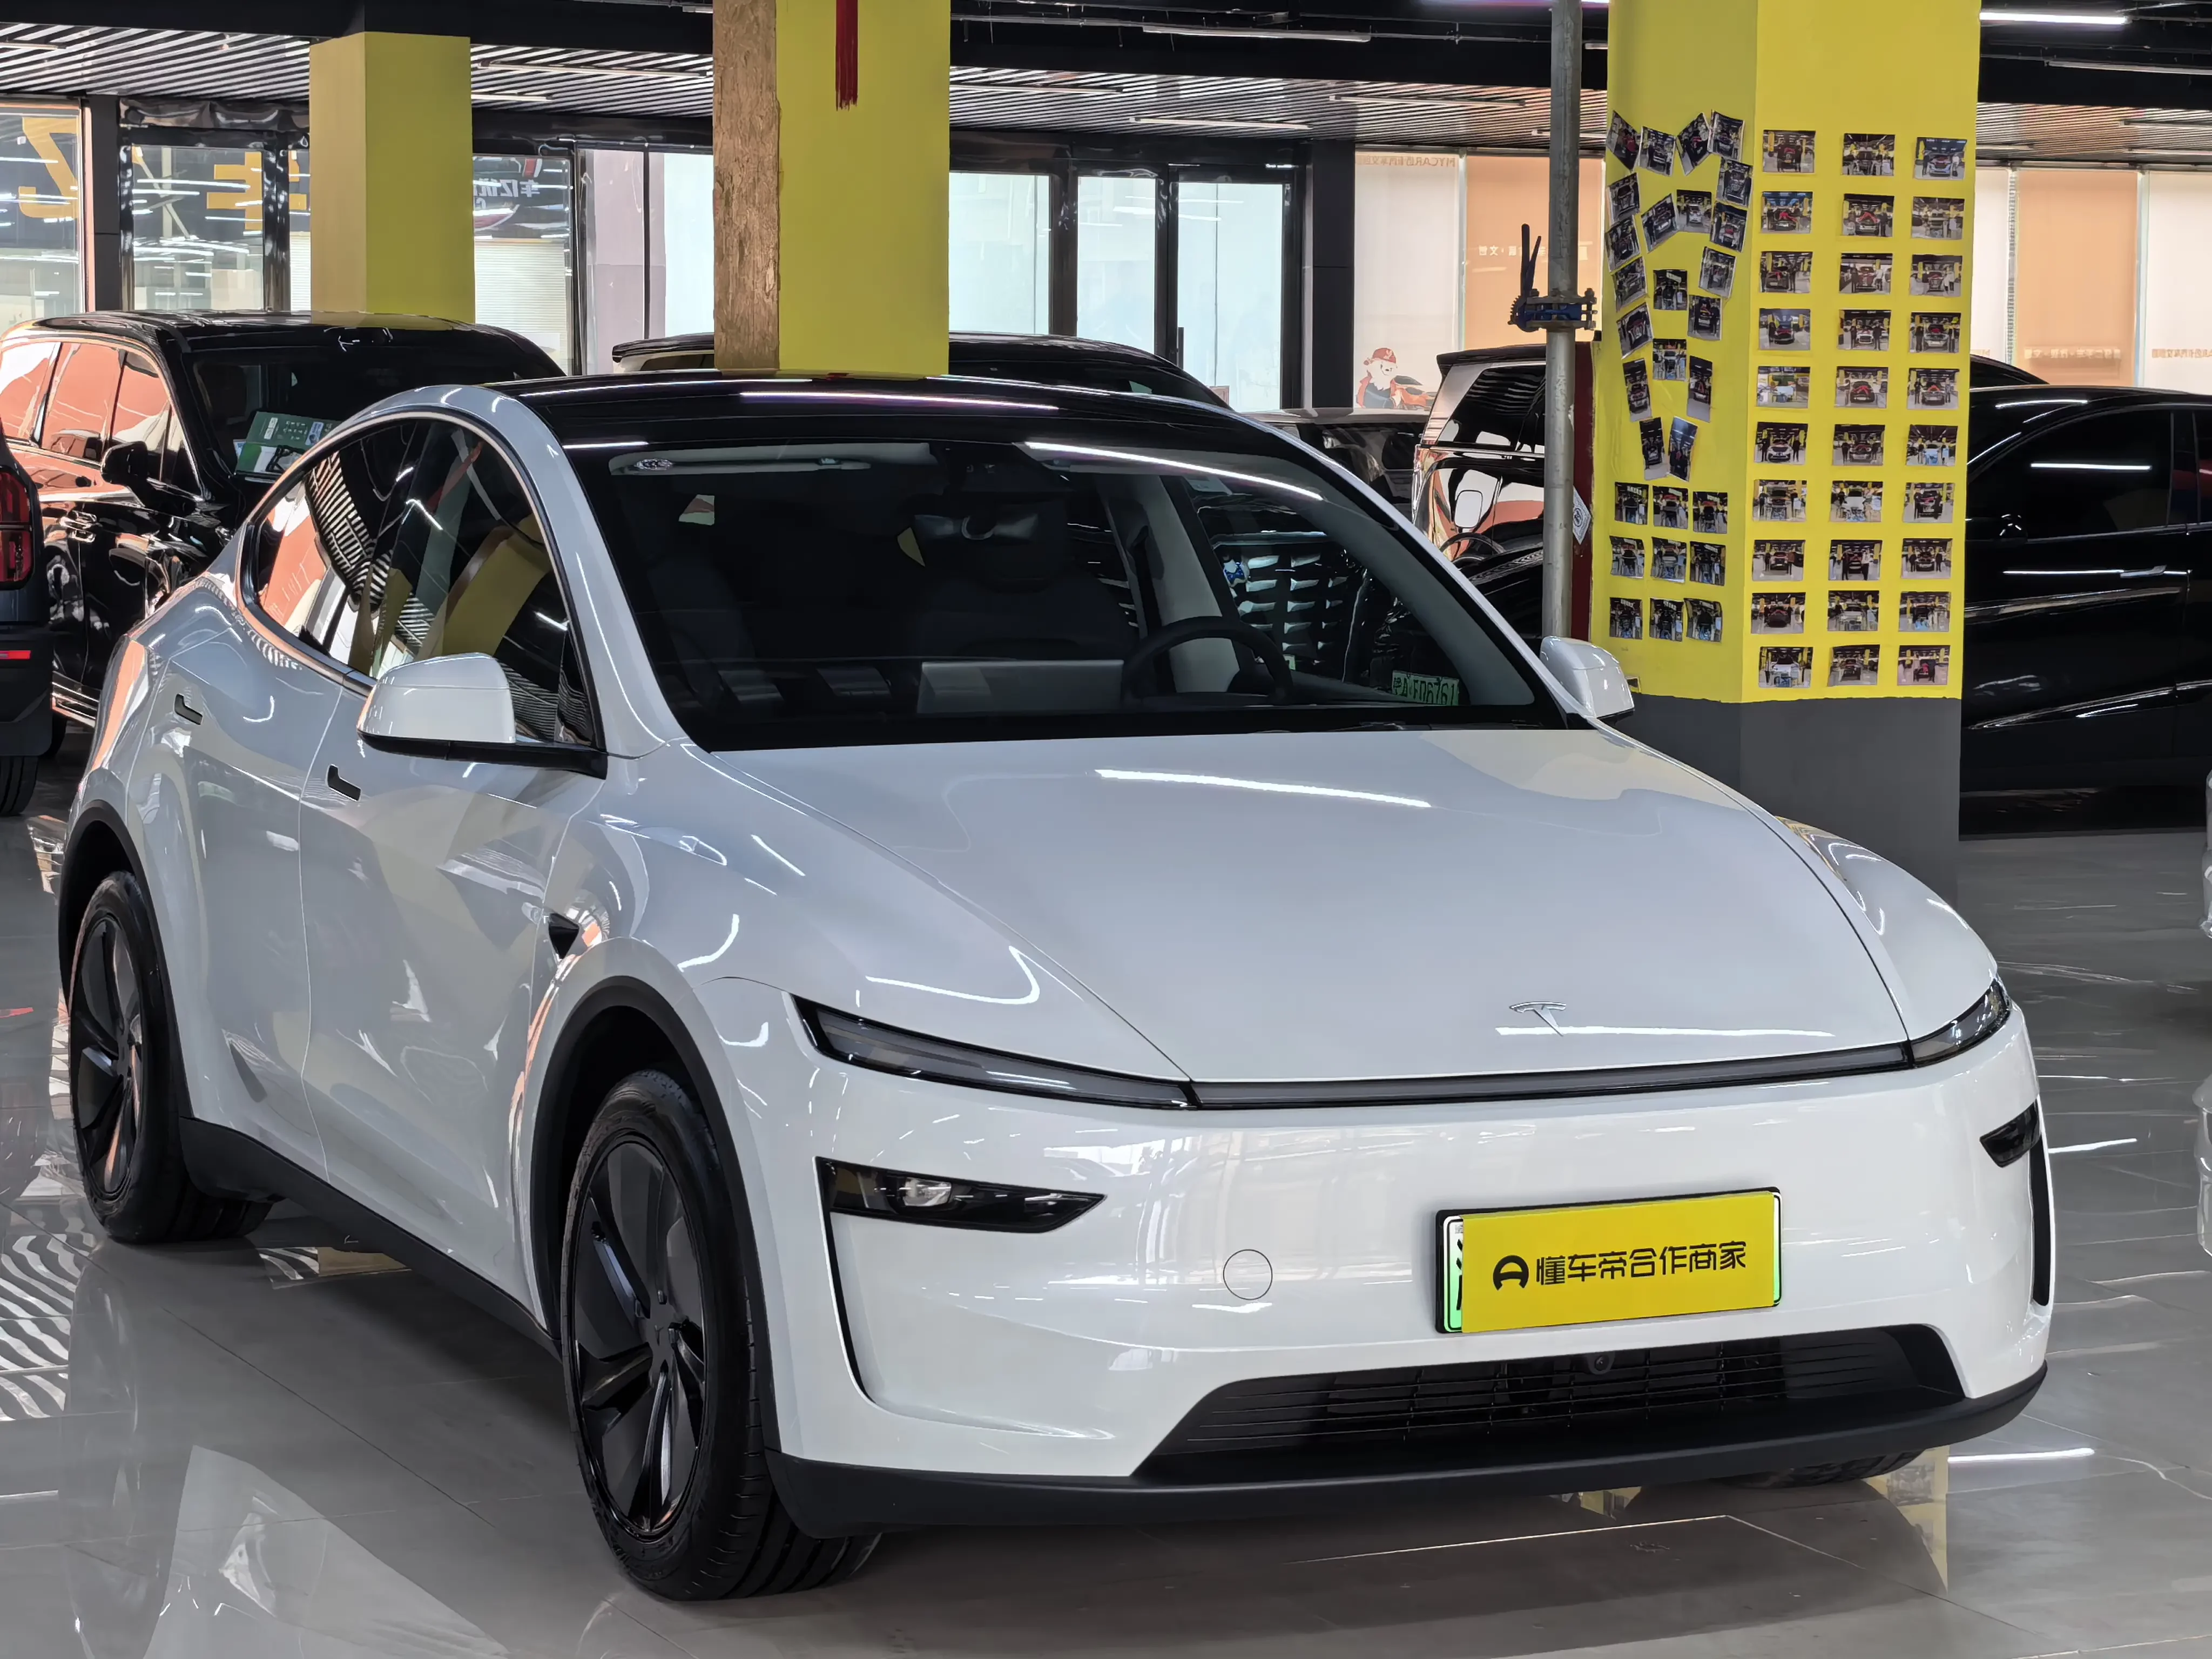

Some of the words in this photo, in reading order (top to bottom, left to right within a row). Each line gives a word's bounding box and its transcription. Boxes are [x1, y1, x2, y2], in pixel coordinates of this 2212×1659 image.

[1536, 1240, 1747, 1286] 懂车帝合作商家
